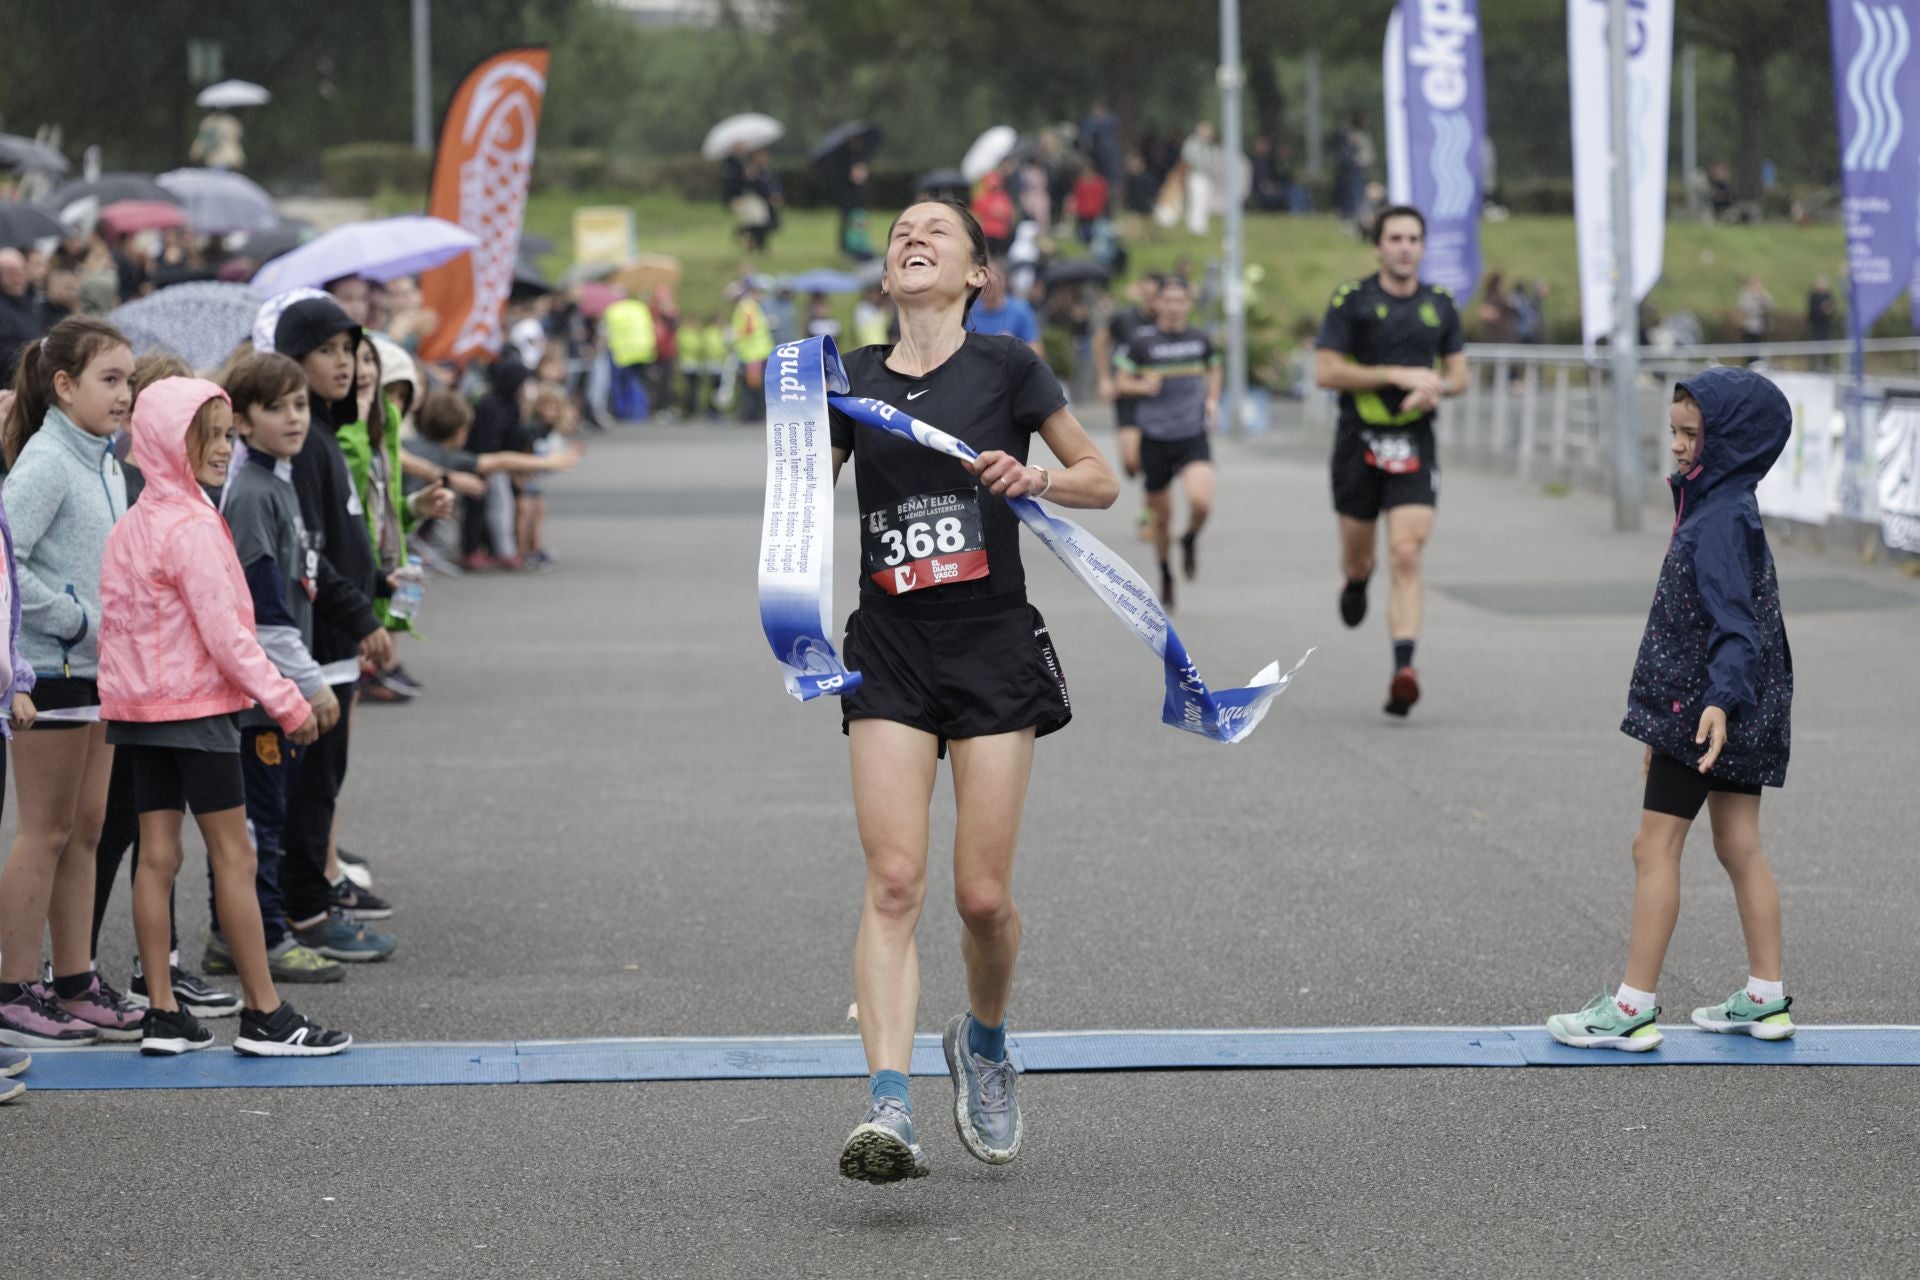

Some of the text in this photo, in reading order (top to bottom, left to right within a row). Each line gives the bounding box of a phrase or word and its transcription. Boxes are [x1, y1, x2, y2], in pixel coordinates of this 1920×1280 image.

[777, 341, 806, 402] gudi
[898, 494, 957, 515] BEÑAT ELZO
[905, 510, 926, 520] MENDI
[927, 504, 965, 516] LASTERKETA
[881, 517, 965, 566] 368
[933, 563, 958, 573] DIARIO
[934, 570, 958, 579] VASCO
